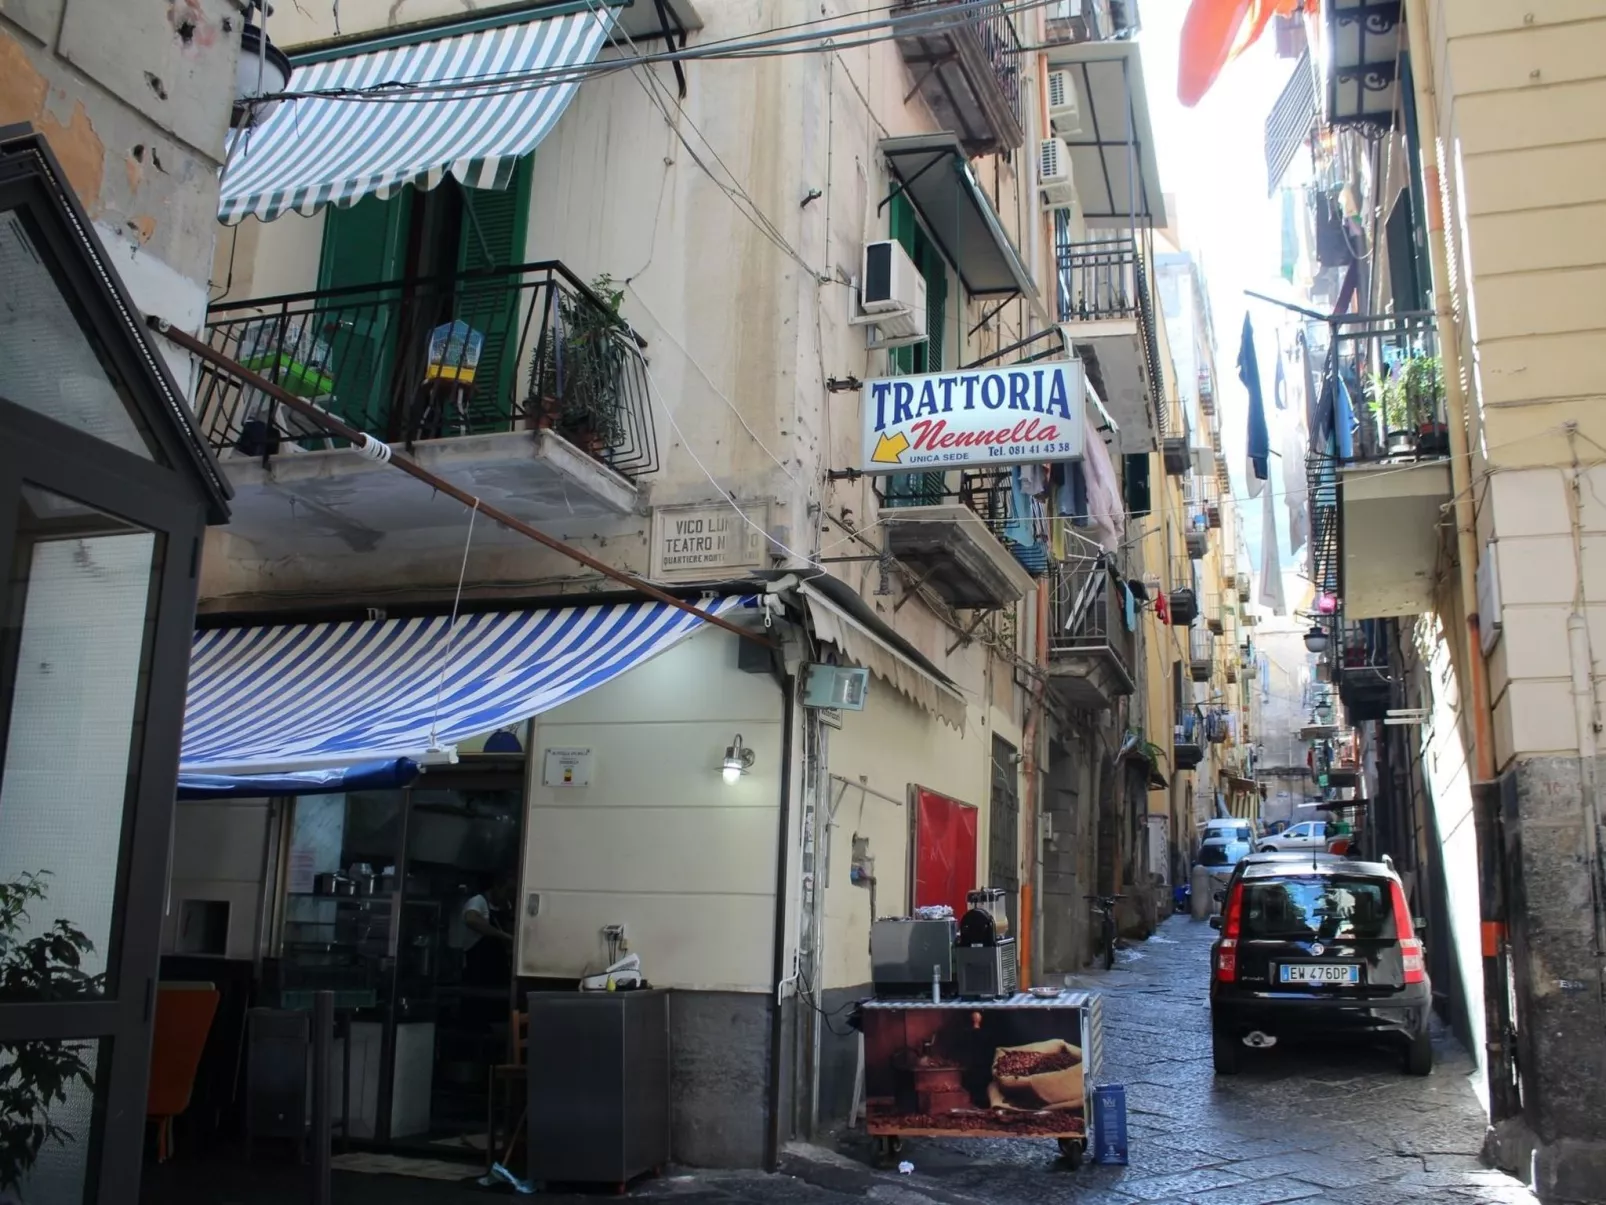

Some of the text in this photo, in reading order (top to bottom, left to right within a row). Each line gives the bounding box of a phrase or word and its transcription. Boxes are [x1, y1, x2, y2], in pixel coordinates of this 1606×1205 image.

[872, 368, 1071, 432] TRATTORIA
[910, 418, 1060, 451] Nennella
[988, 442, 1070, 457] Tel. 081 41 43 38
[910, 452, 969, 463] UNICA SEDE
[676, 519, 703, 535] VICO
[666, 536, 712, 553] TEATRO
[663, 554, 702, 567] QUARTIERE
[1290, 967, 1348, 980] EW 476DP
